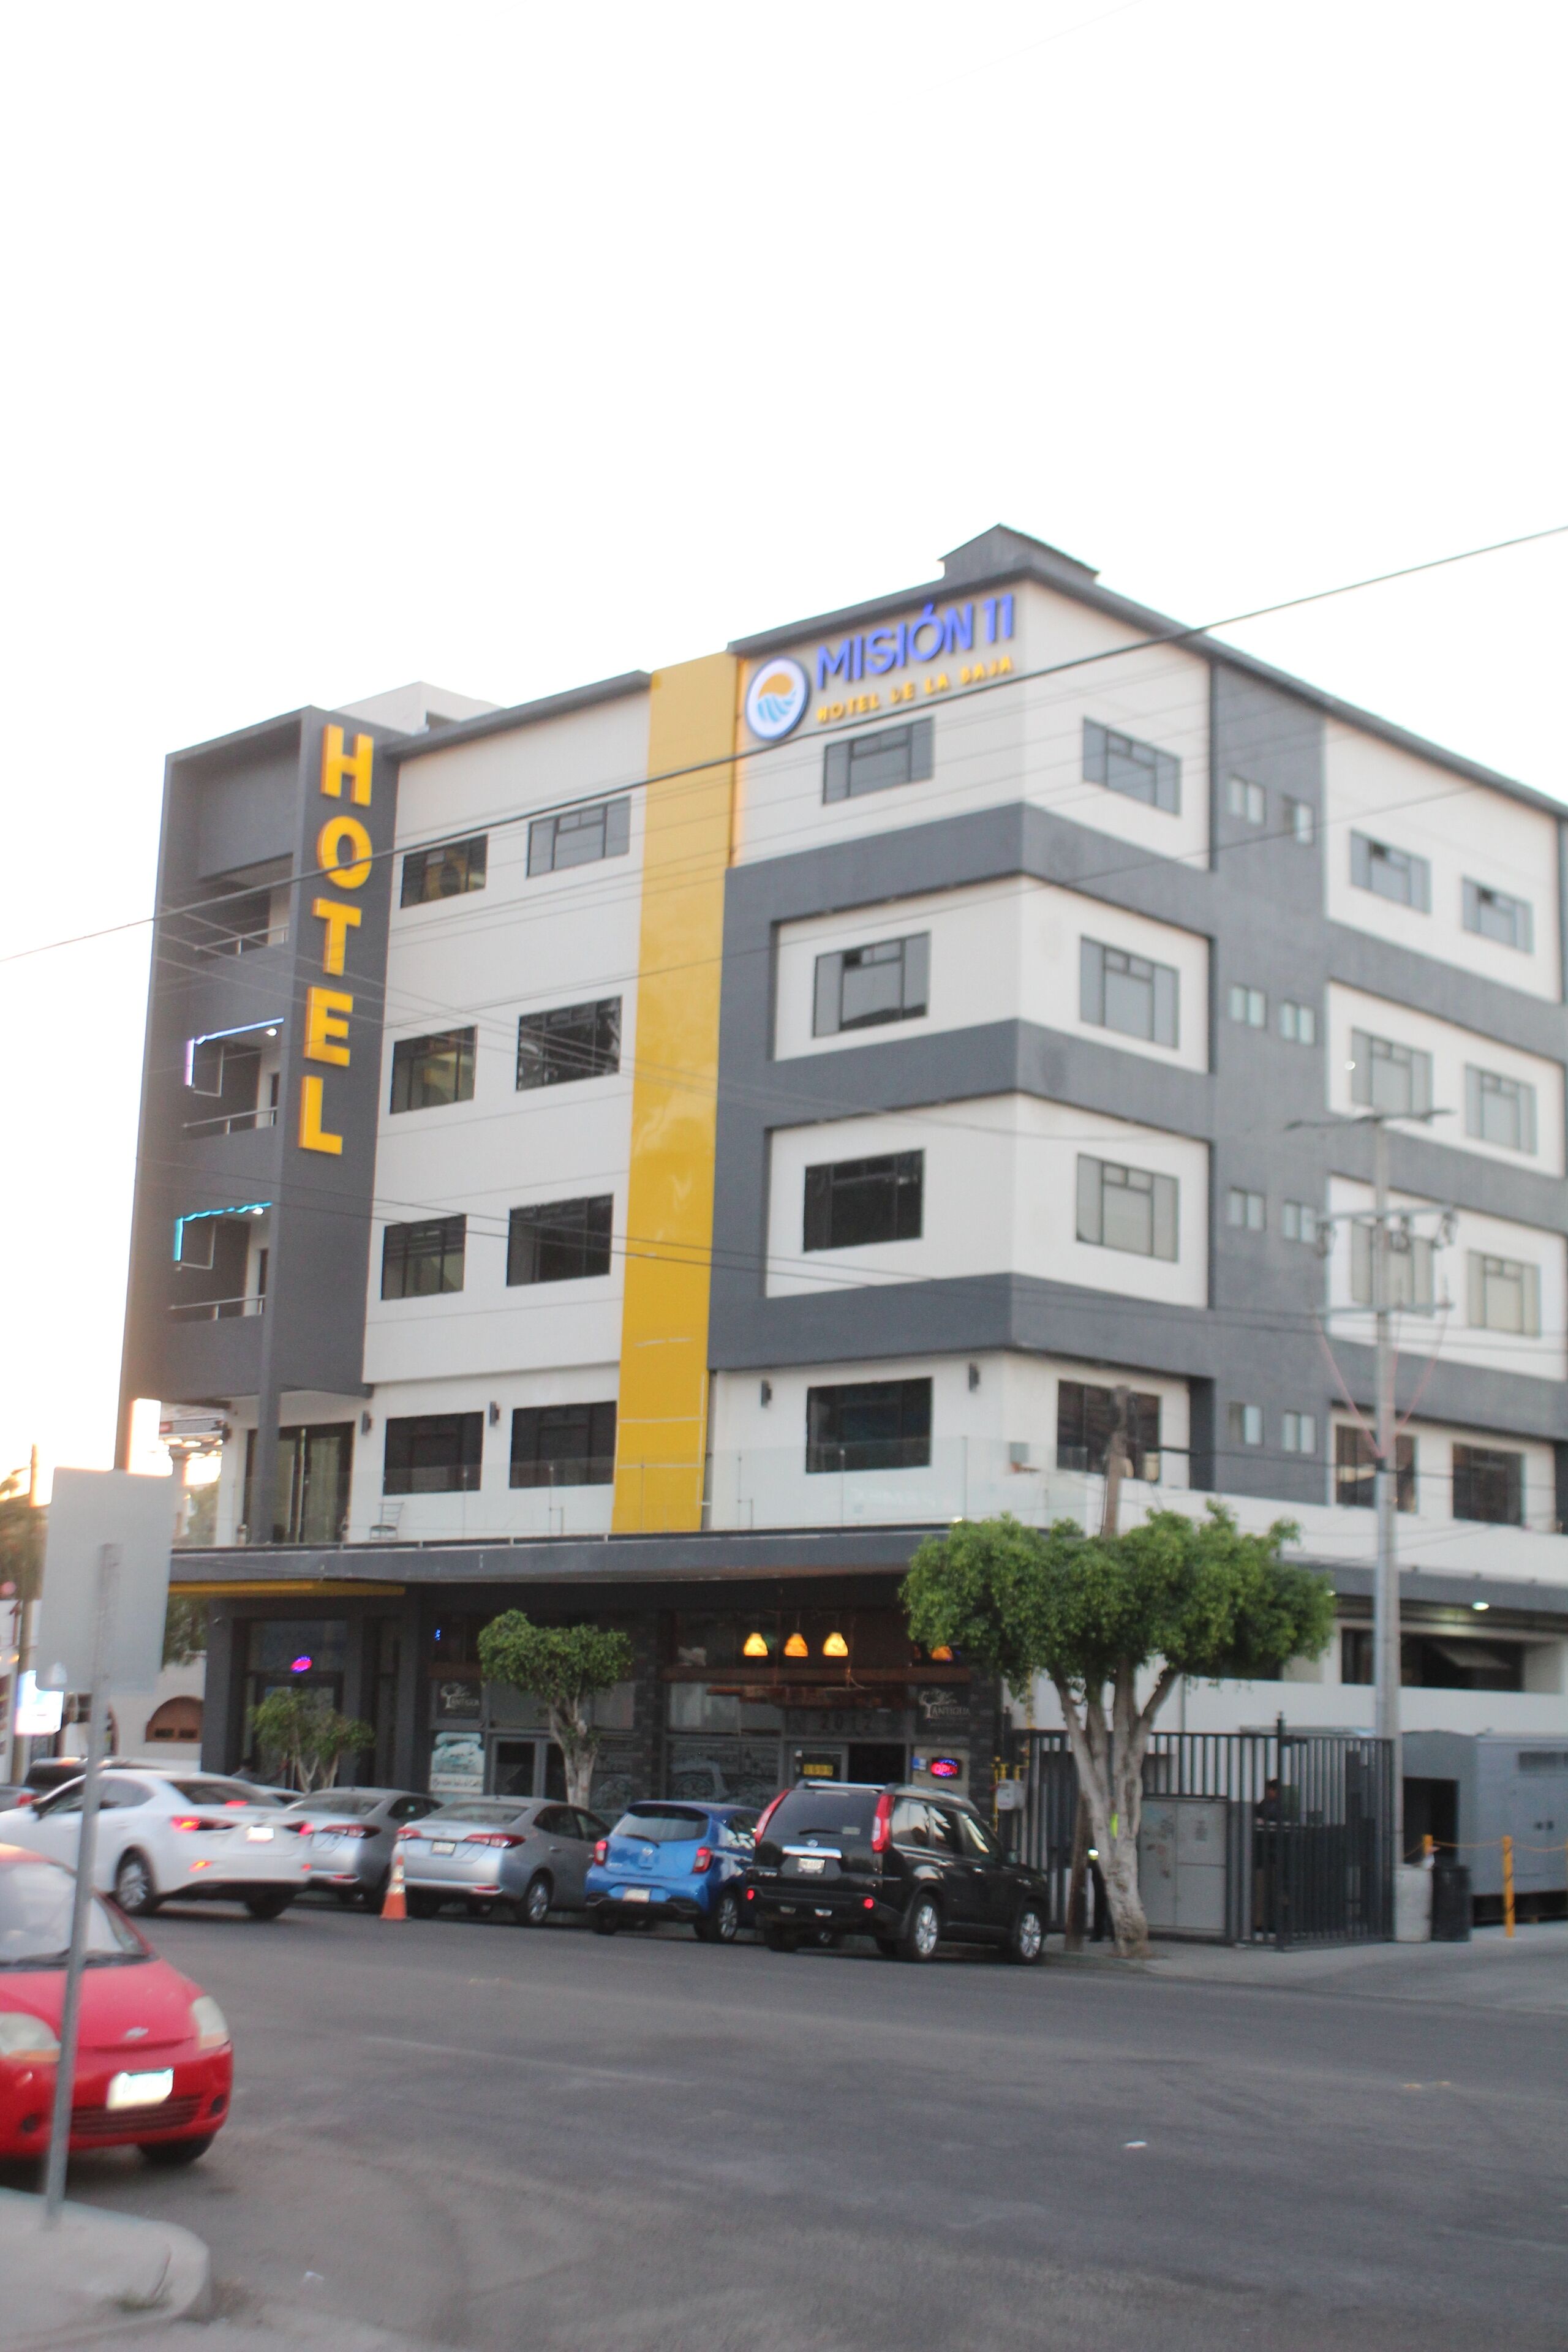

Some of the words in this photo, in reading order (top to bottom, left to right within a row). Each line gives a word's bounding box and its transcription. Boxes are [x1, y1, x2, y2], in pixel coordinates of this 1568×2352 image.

[816, 602, 973, 690] MISIÓN
[982, 593, 1014, 644] 11
[816, 692, 879, 723] HOTEL
[891, 681, 915, 703] DE
[924, 673, 949, 695] LA
[960, 655, 1014, 685] BAJA
[299, 723, 373, 1155] HOTEL
